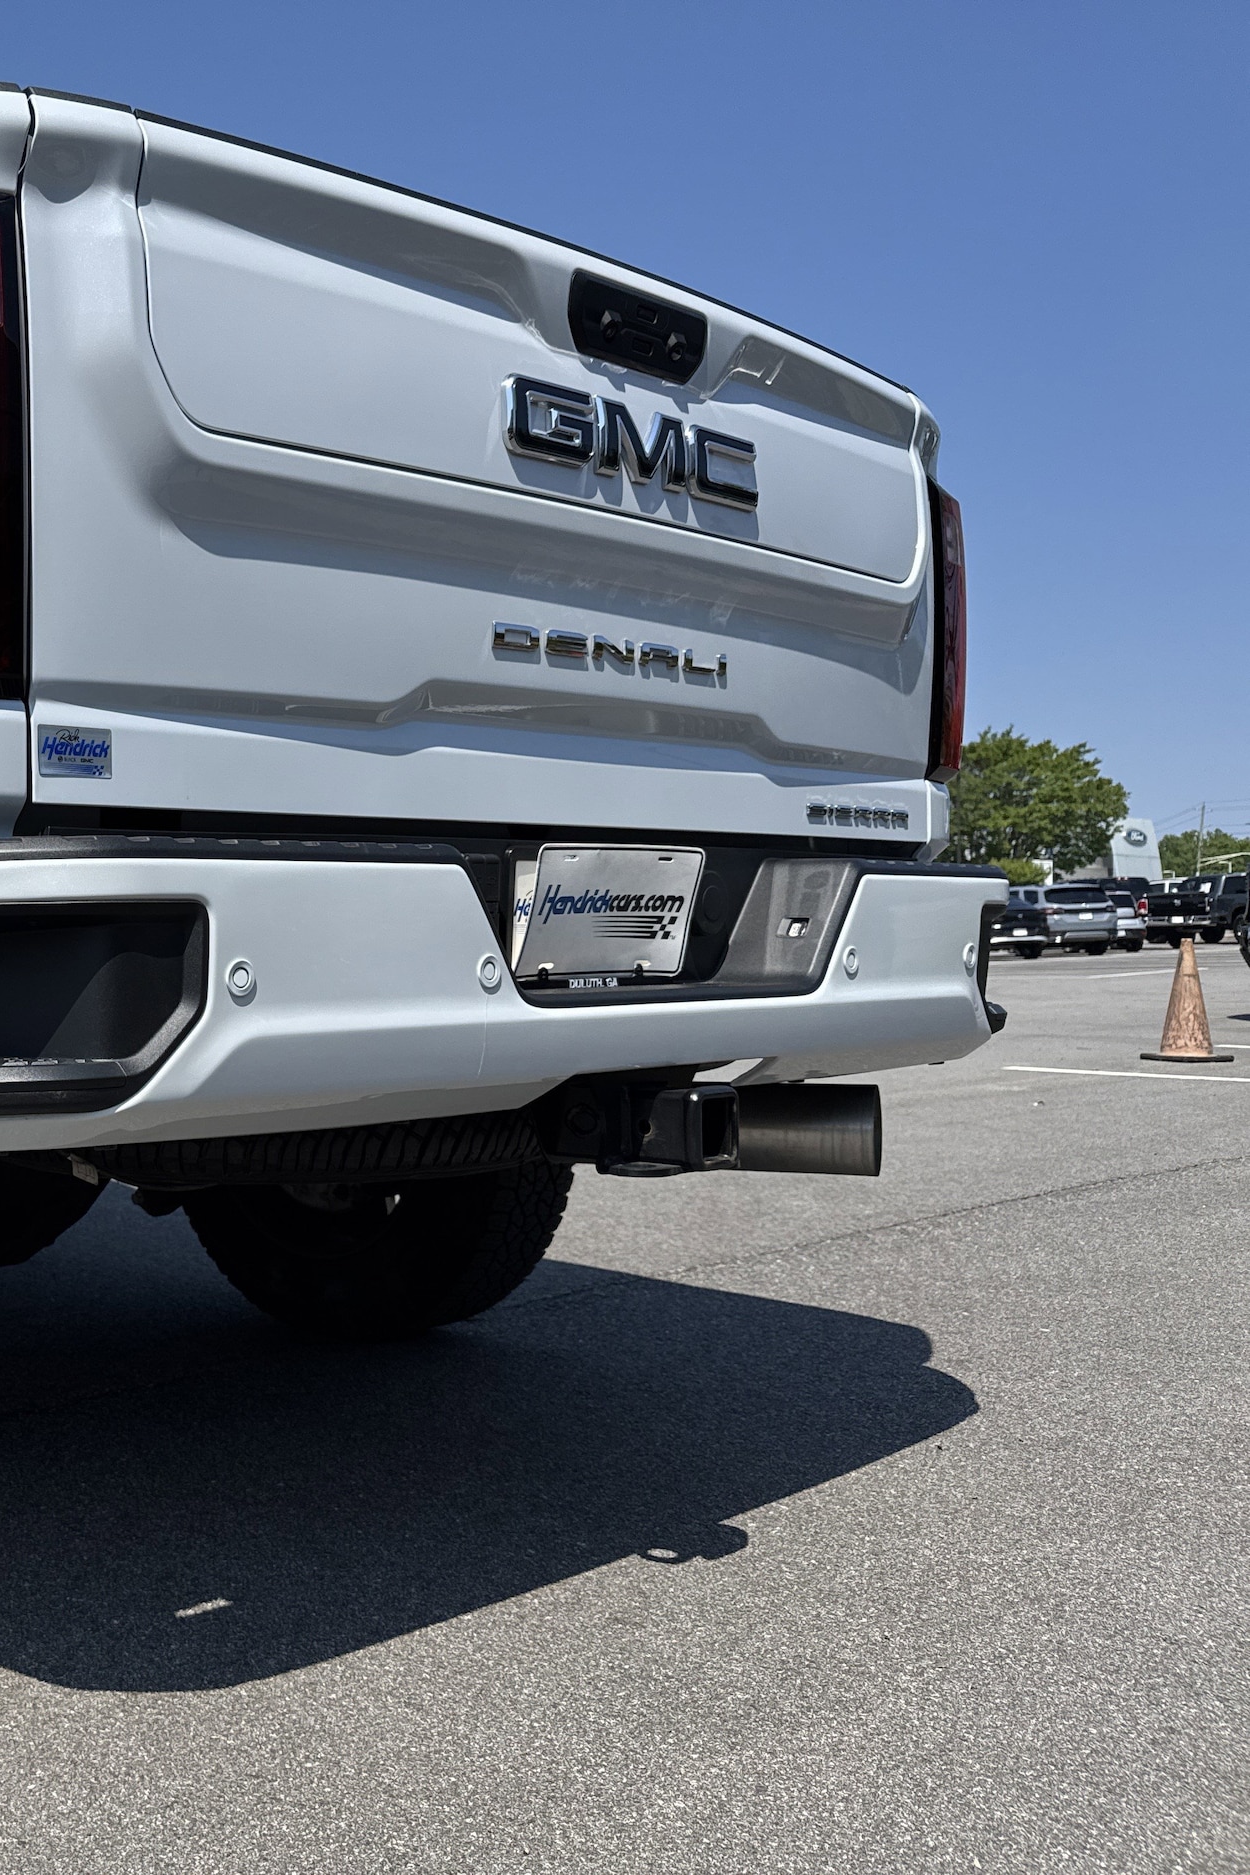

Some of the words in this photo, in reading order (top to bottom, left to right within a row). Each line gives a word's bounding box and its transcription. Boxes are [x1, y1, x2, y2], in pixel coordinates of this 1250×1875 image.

[503, 374, 758, 511] GMC
[492, 620, 727, 676] DENALI
[41, 736, 109, 760] Hendrick
[806, 803, 908, 821] SIERRA
[538, 884, 684, 925] Hendrickcars.com
